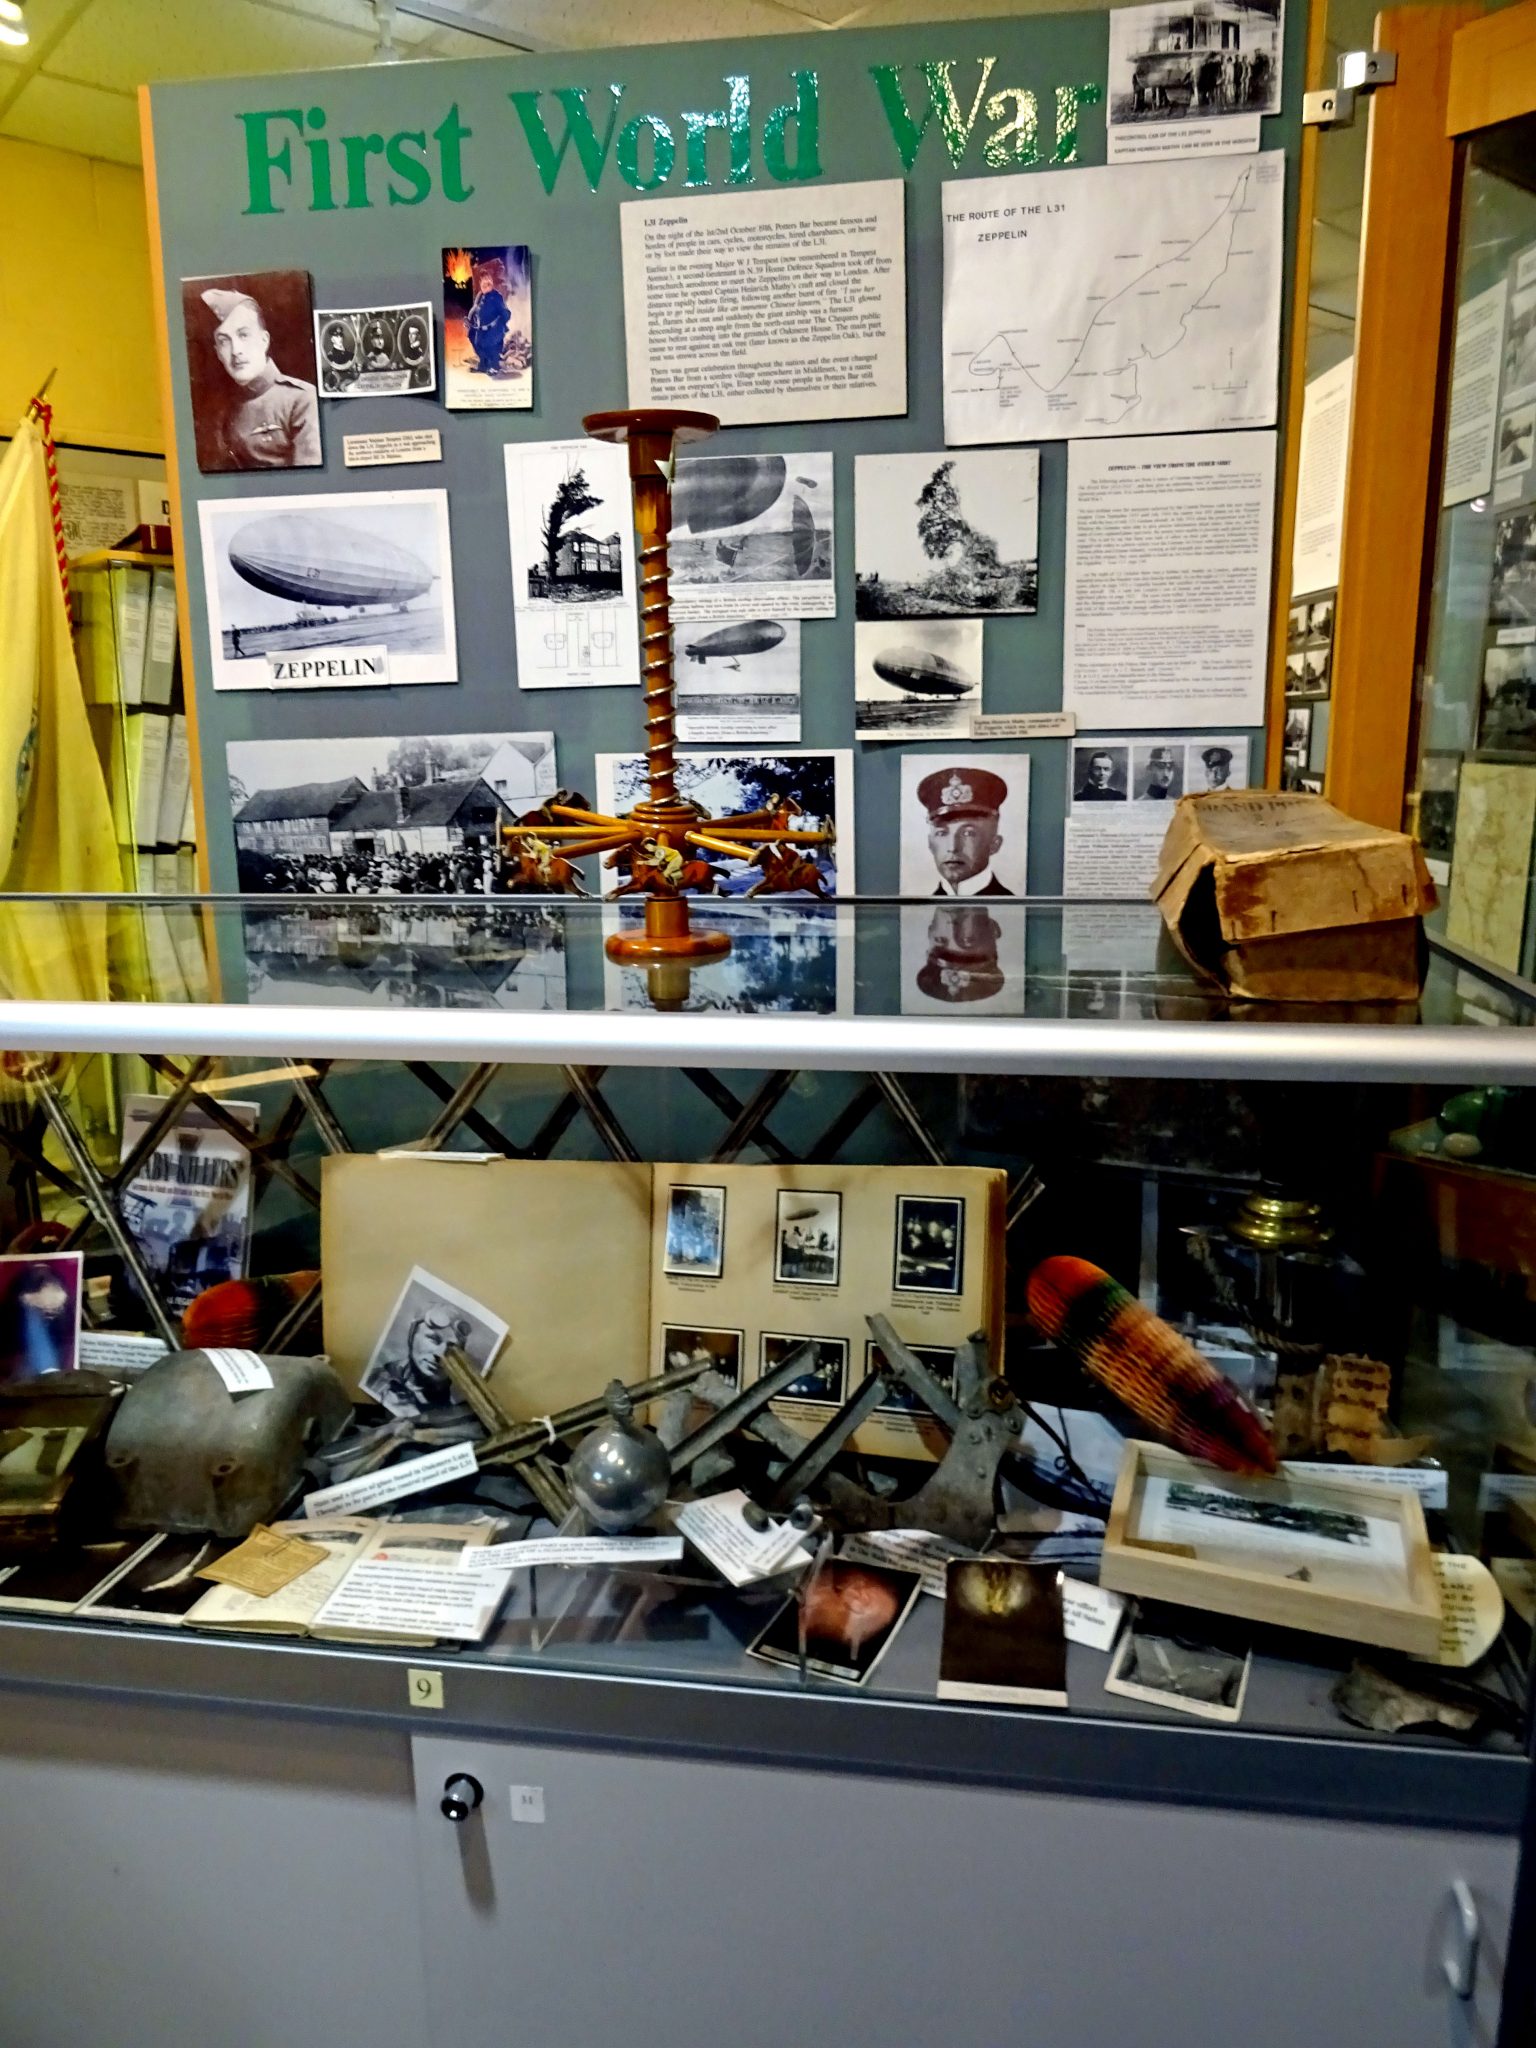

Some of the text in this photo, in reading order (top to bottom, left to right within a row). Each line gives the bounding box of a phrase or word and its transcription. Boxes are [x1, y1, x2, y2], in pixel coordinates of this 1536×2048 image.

[234, 55, 1101, 216] First World War
[658, 216, 688, 226] Zeppelin
[947, 213, 965, 222] THE
[969, 210, 1000, 220] ROUTE
[1004, 207, 1017, 217] OF
[1021, 205, 1041, 215] THE
[667, 230, 683, 239] night
[729, 225, 756, 233] October
[775, 221, 796, 230] Potters
[812, 218, 837, 227] became
[839, 216, 862, 224] famous
[675, 239, 696, 248] people
[788, 230, 806, 238] hired
[858, 225, 876, 233] horse
[977, 230, 1028, 242] ZEPPELIN
[677, 248, 694, 256] made
[696, 246, 711, 254] their
[765, 241, 790, 249] remains
[715, 259, 734, 269] Major
[752, 256, 778, 266] Tempest
[850, 248, 876, 258] Tempest
[786, 262, 812, 271] Defence
[815, 260, 845, 270] Squadron
[875, 256, 892, 264] from
[646, 281, 683, 290] Hornchurch
[758, 273, 790, 283] Zeppelins
[714, 286, 738, 296] Captain
[740, 284, 768, 292] Heinrich
[828, 278, 849, 286] closed
[769, 300, 795, 308] Chinese
[858, 294, 881, 303] glowed
[860, 312, 880, 321] public
[779, 326, 808, 334] Oakmere
[812, 332, 840, 342] Zeppelin
[734, 371, 755, 379] village
[792, 375, 813, 384] people
[786, 384, 821, 392] themselves
[273, 657, 378, 681] ZEPPELIN
[416, 1678, 432, 1699] 9
